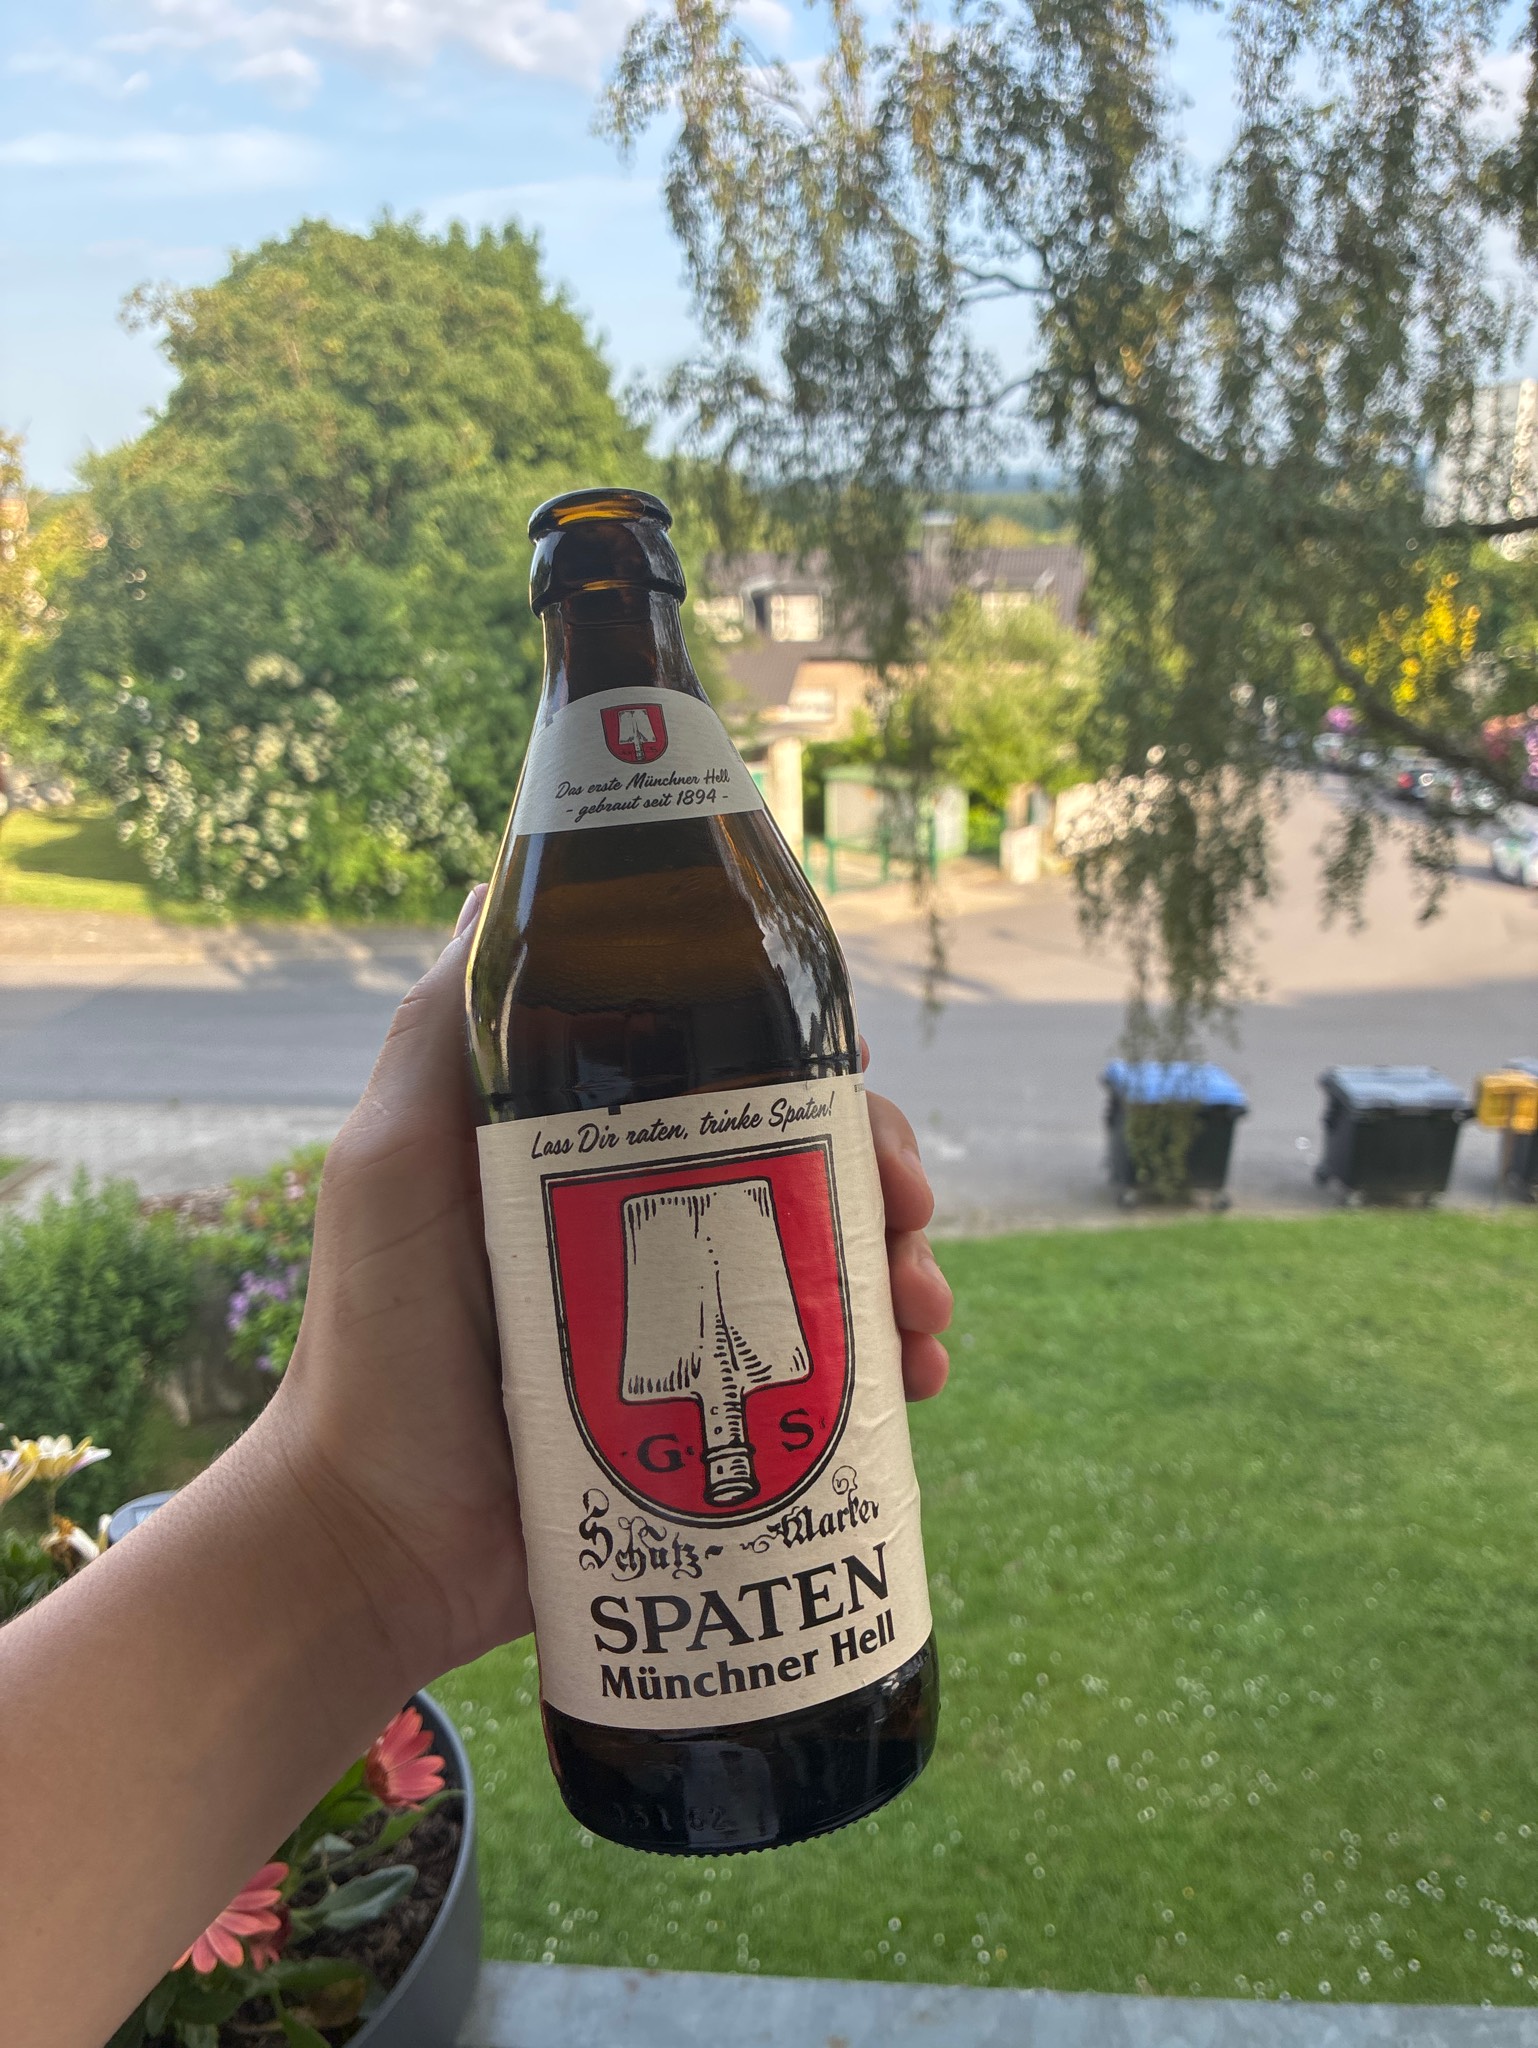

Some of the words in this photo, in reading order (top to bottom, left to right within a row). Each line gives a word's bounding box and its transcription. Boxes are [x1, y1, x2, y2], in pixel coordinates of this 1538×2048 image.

[555, 780, 584, 799] Das
[588, 777, 622, 793] erste
[625, 770, 701, 790] Münchner
[703, 768, 731, 785] Hell
[575, 796, 640, 823] gebraut
[643, 792, 672, 809] seit
[676, 789, 717, 806] 1894
[531, 1131, 574, 1159] Lass
[578, 1123, 620, 1153] Dir
[626, 1118, 689, 1146] raten,
[700, 1102, 763, 1136] trinke
[768, 1091, 835, 1133] Spaten!
[779, 1408, 815, 1452] S
[590, 1542, 889, 1655] SPATEN
[600, 1648, 819, 1701] Münchner
[830, 1608, 896, 1668] Hell
